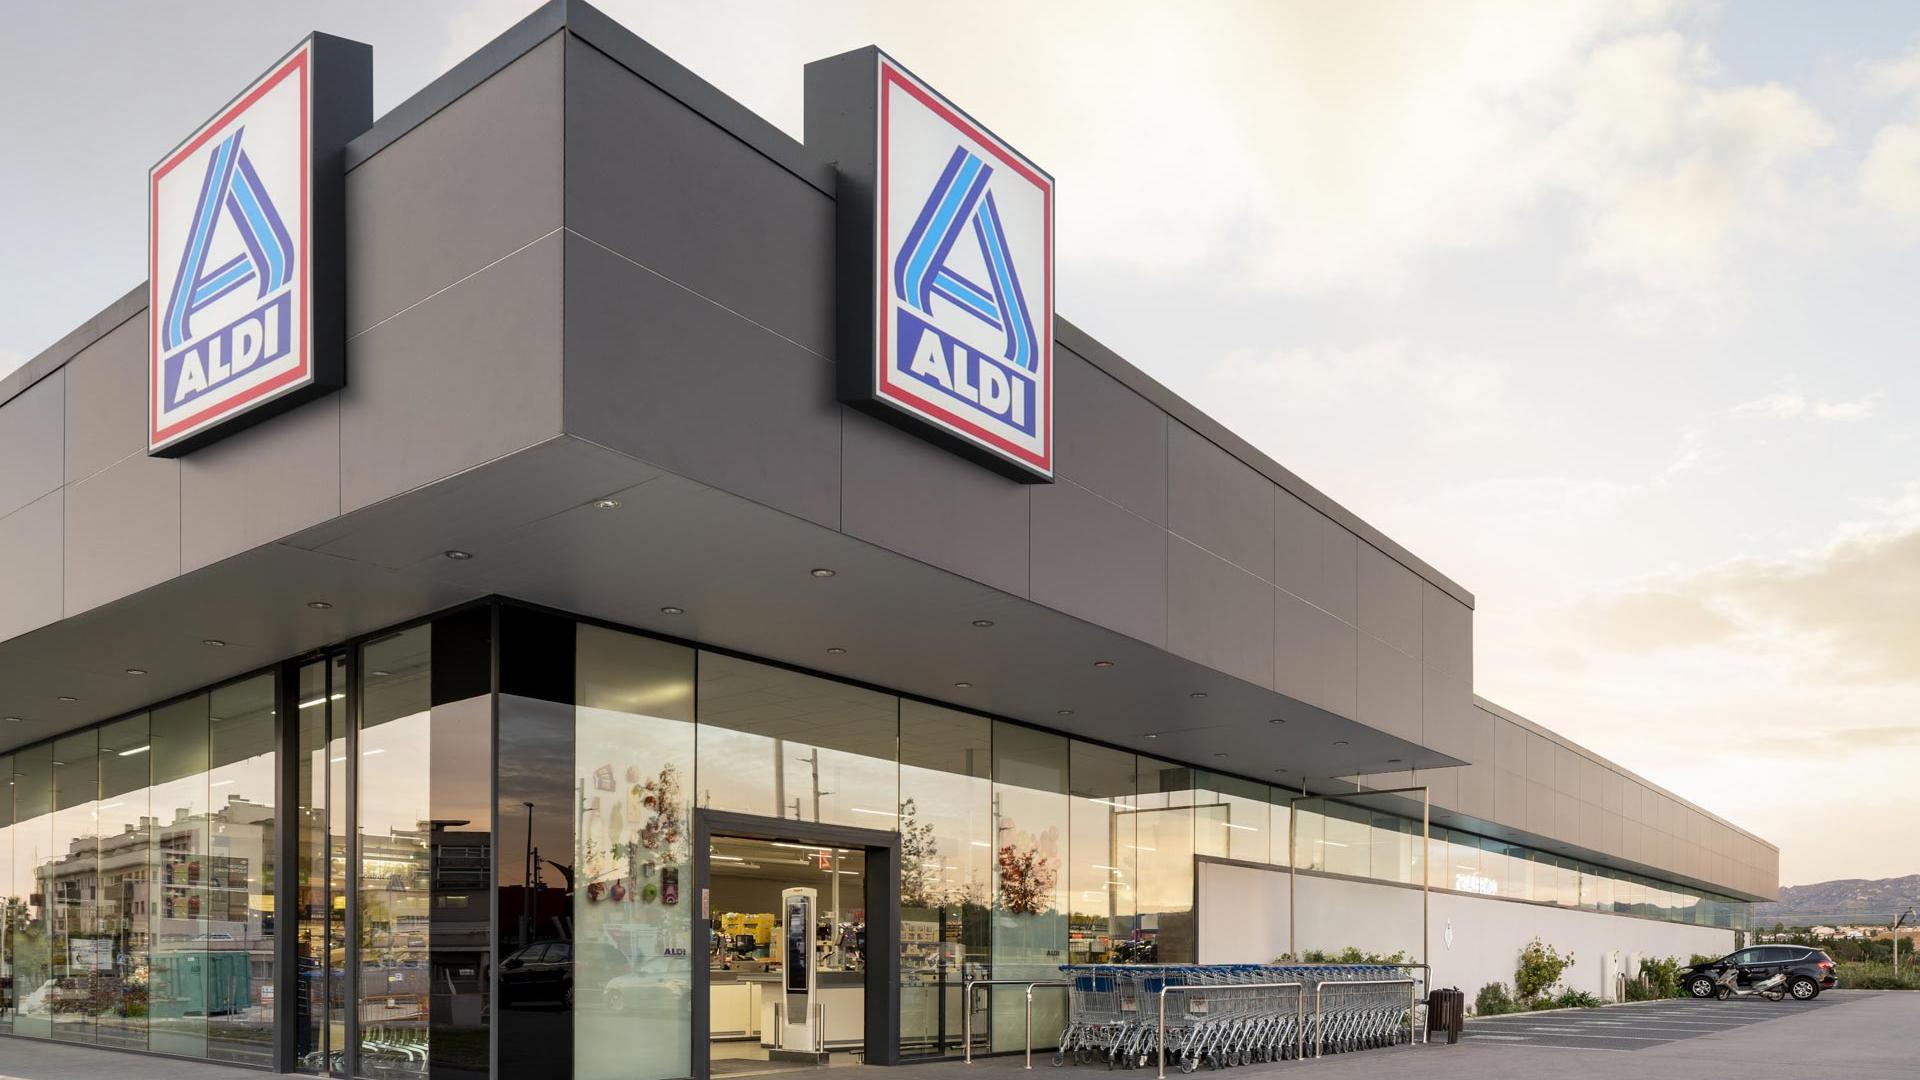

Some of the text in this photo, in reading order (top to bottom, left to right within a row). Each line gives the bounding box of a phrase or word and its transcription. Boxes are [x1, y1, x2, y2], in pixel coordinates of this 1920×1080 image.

[174, 304, 279, 403] ALDI
[910, 328, 1024, 427] ALDI
[664, 948, 686, 956] ALDI
